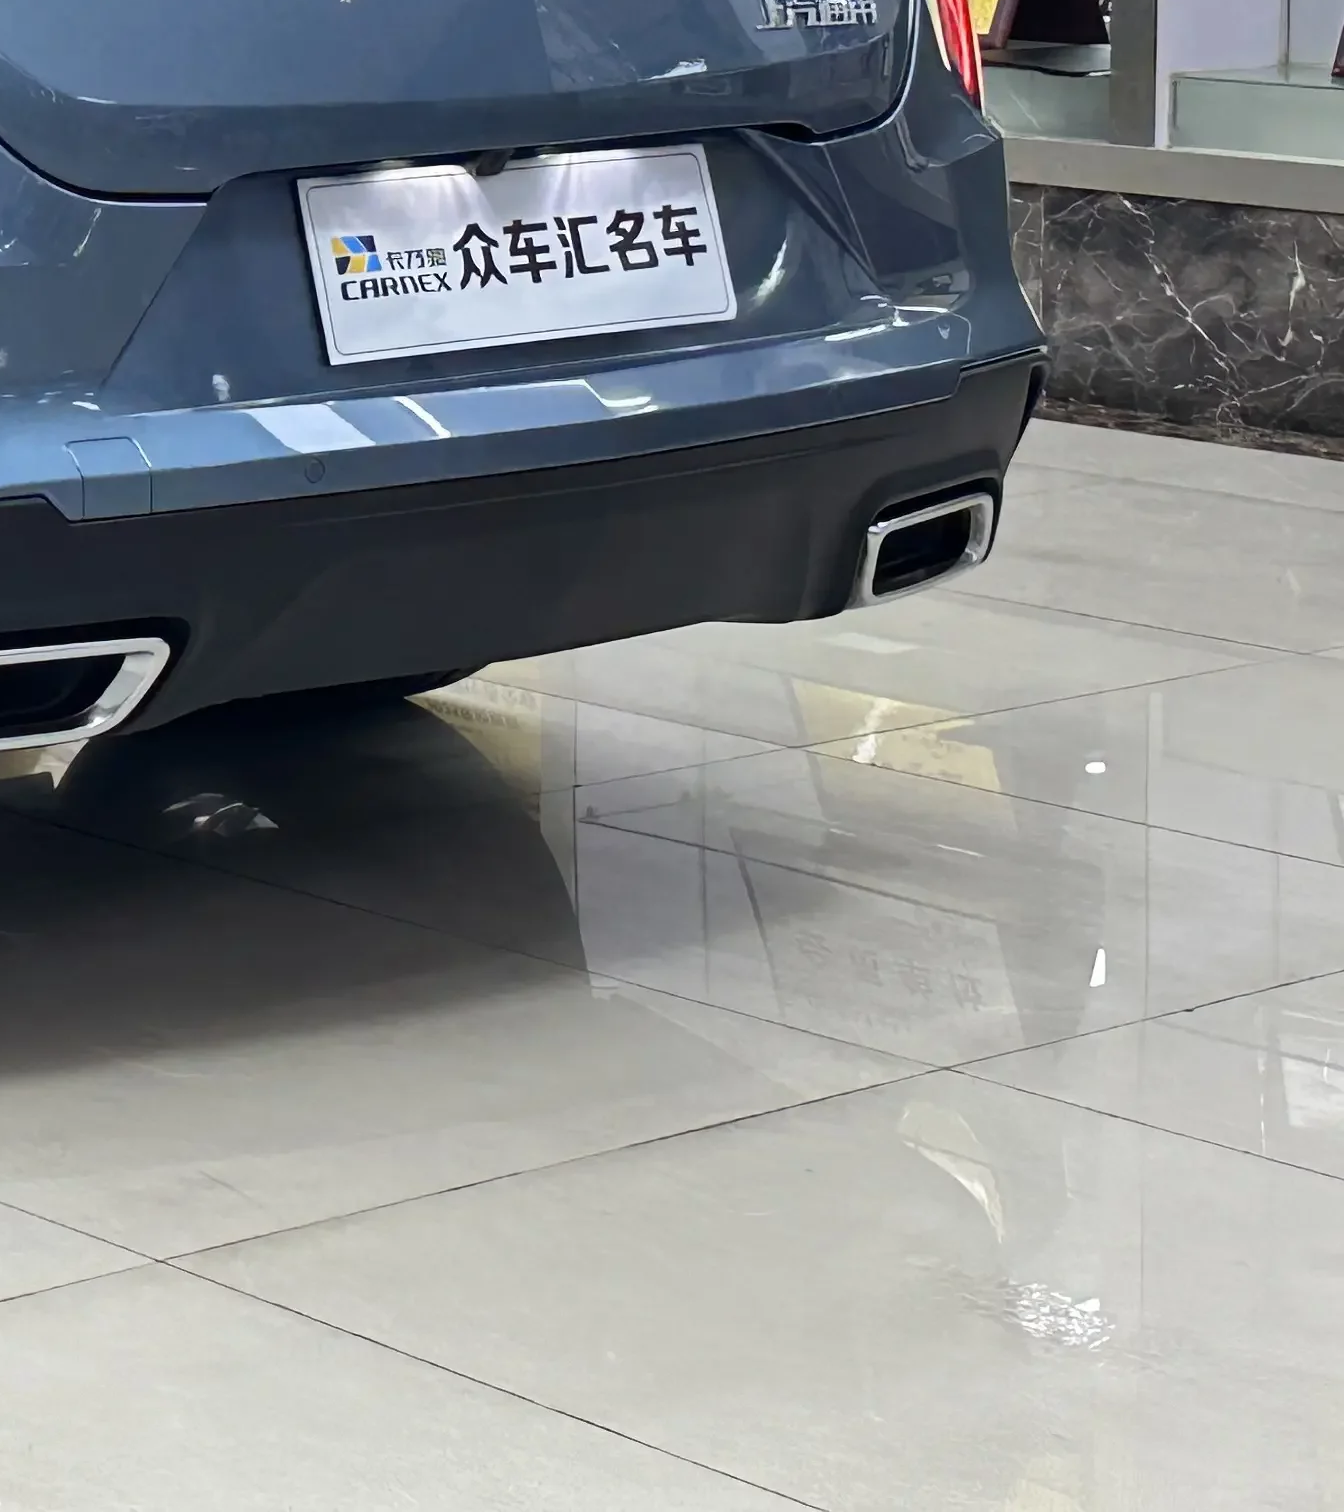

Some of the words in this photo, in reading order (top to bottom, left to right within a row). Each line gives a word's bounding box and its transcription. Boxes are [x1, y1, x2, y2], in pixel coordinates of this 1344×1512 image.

[385, 247, 448, 270] 卡乃驰
[452, 204, 708, 291] 众车汇名车
[340, 271, 452, 301] CARNEX
